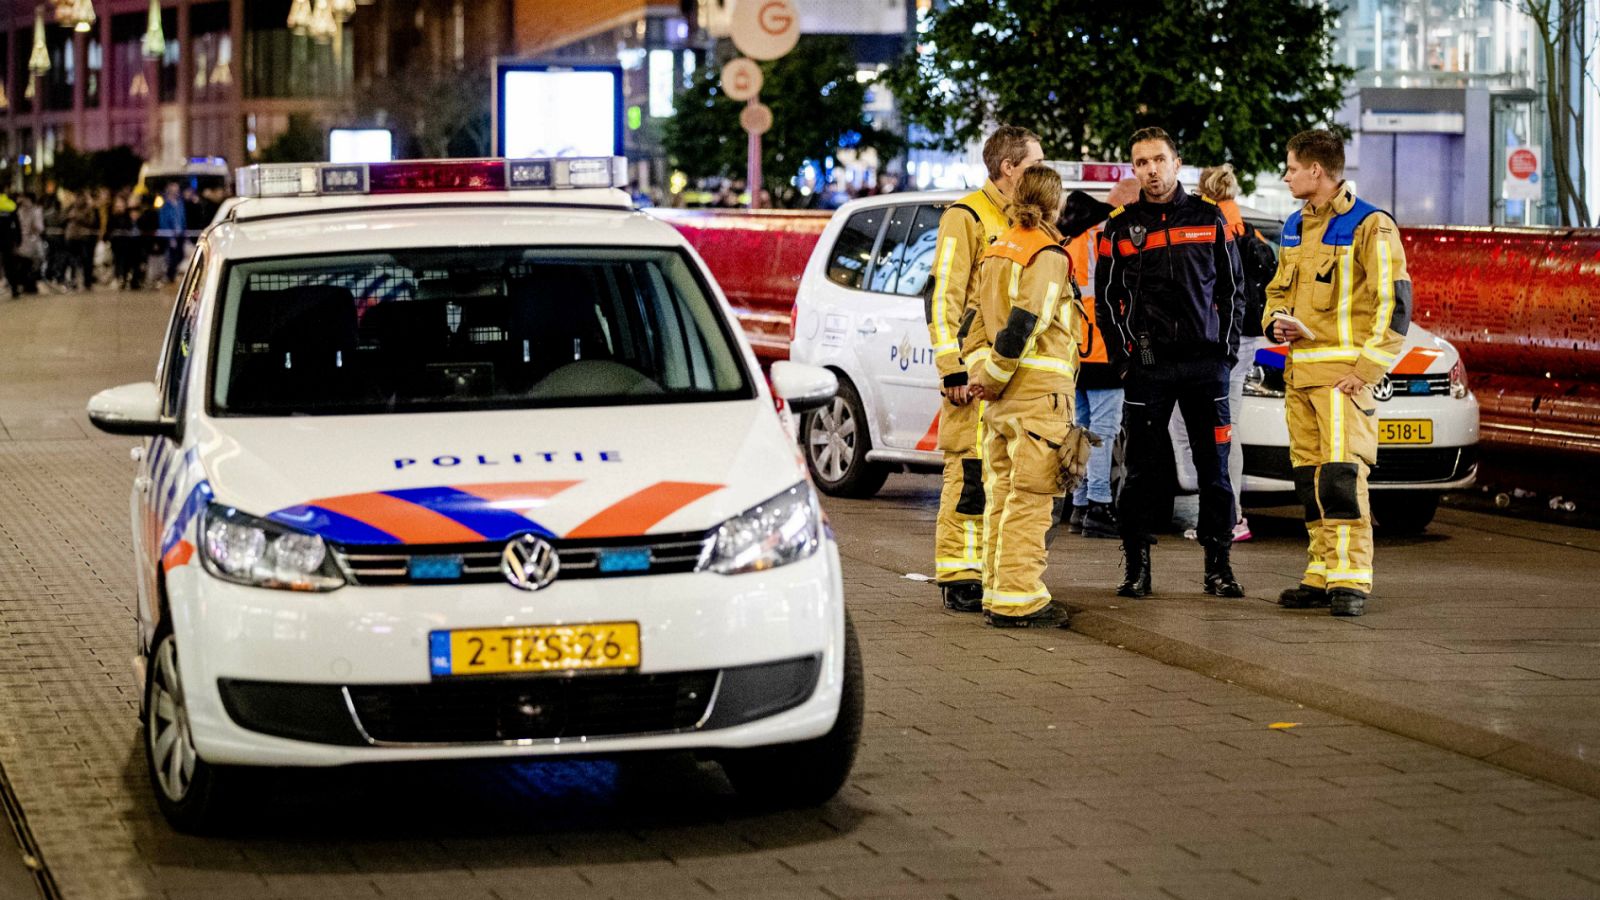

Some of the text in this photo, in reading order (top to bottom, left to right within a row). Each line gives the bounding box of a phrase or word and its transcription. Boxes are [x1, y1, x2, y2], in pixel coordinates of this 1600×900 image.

[758, 1, 794, 36] G
[890, 345, 934, 371] POLIT
[1380, 424, 1426, 440] -518-L
[394, 450, 622, 469] POLITIE
[468, 631, 621, 666] 2-TZS-26
